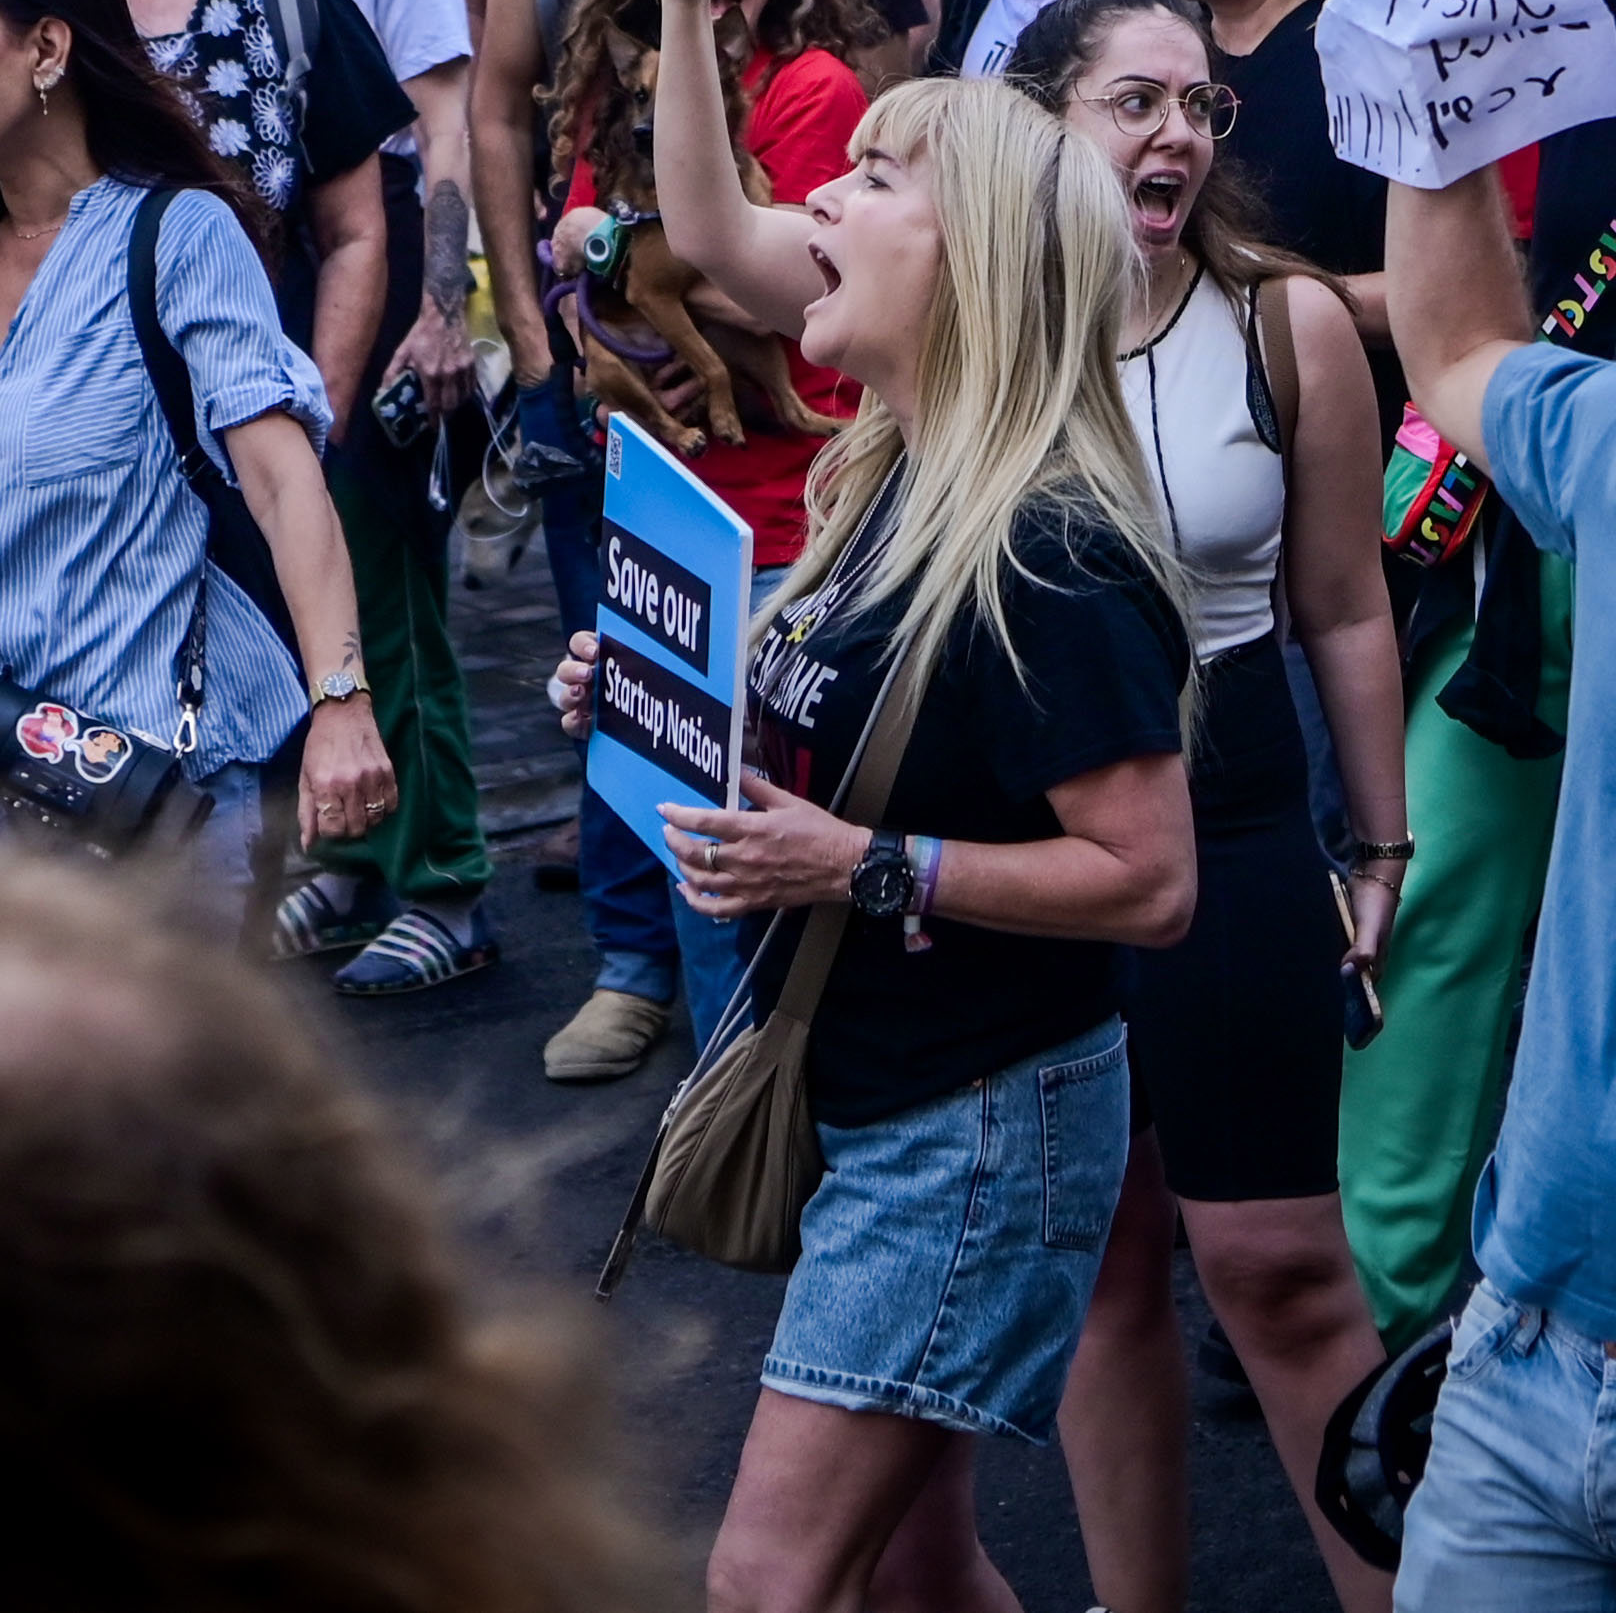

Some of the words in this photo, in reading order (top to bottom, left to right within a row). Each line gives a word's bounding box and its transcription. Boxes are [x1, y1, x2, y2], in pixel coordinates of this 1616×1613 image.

[607, 536, 659, 625] Save
[663, 585, 702, 653] our
[604, 657, 664, 748] Startup
[667, 699, 722, 783] Nation
